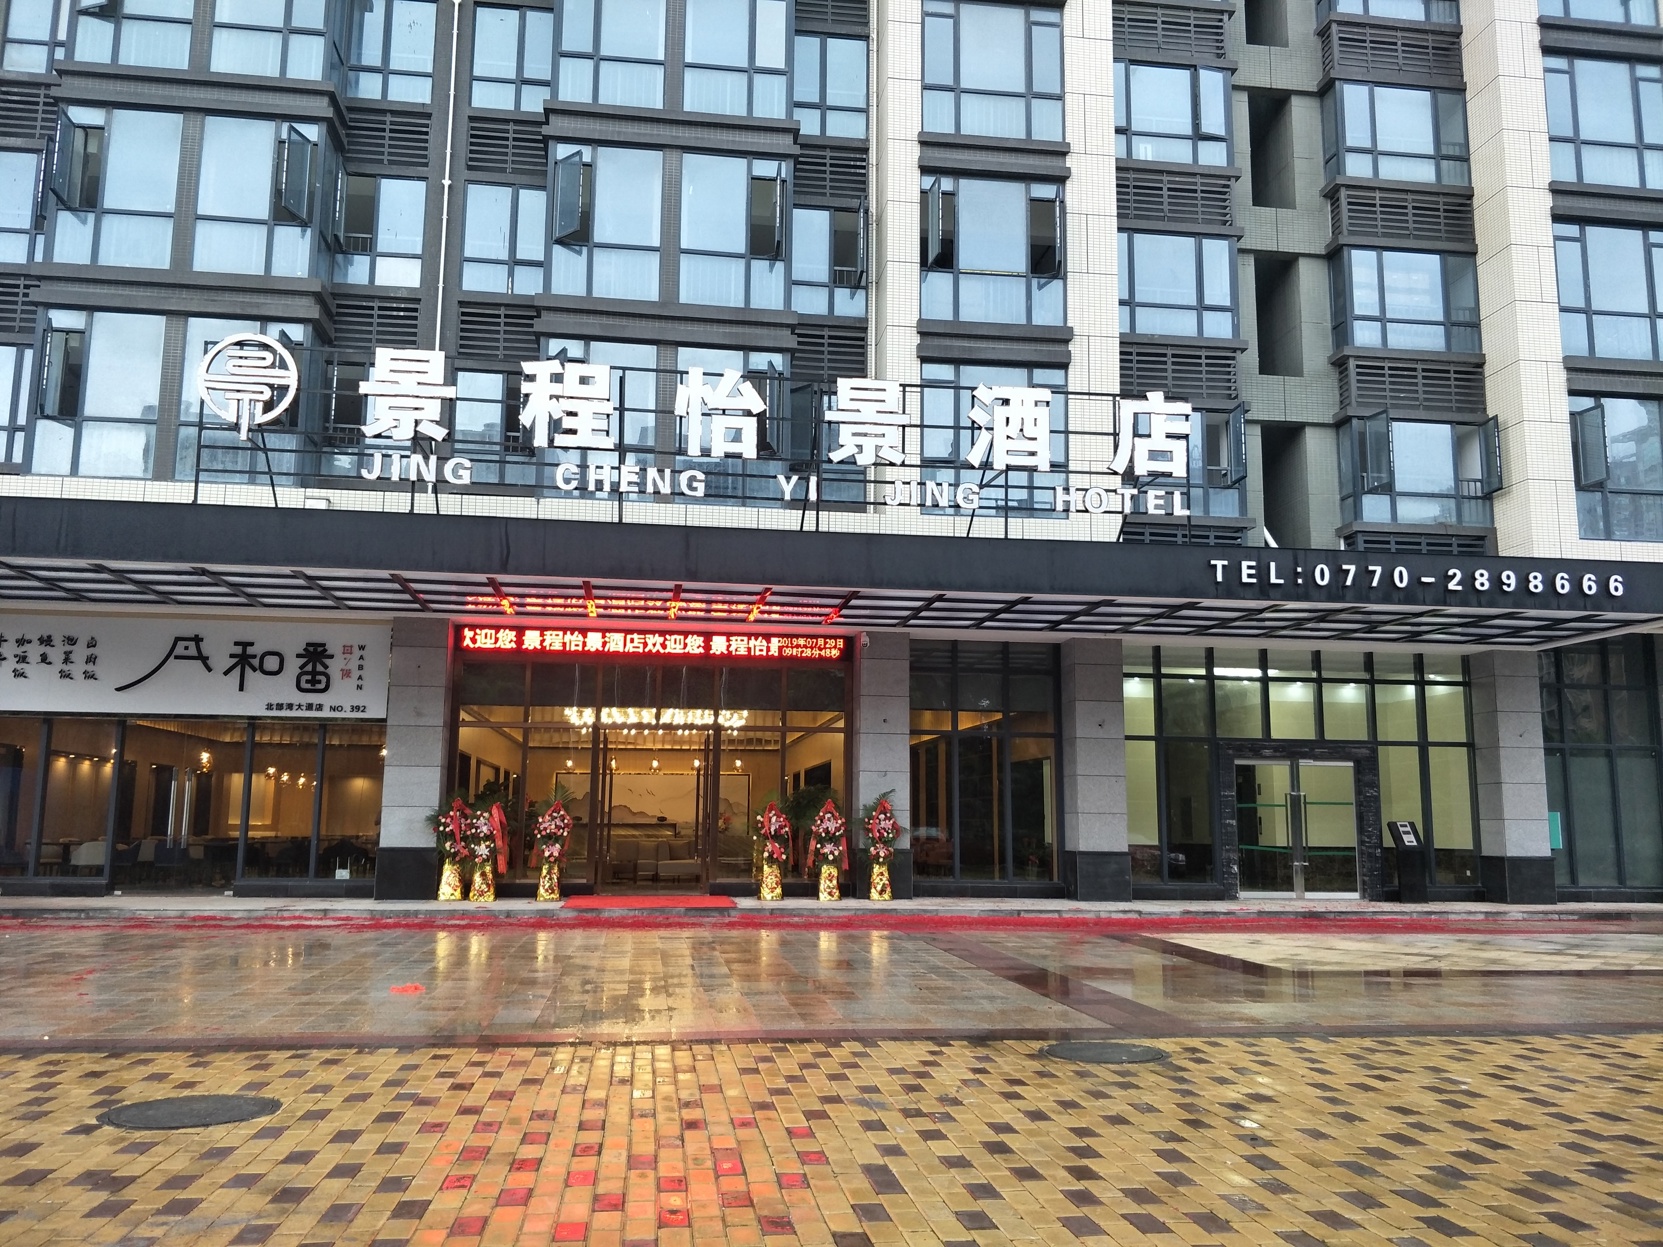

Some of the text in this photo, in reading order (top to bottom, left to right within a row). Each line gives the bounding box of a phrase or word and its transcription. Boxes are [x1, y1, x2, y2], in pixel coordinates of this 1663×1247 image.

[358, 347, 1193, 477] 景程怡景酒店
[360, 451, 1192, 516] JING CHENG YI JING HOTEL
